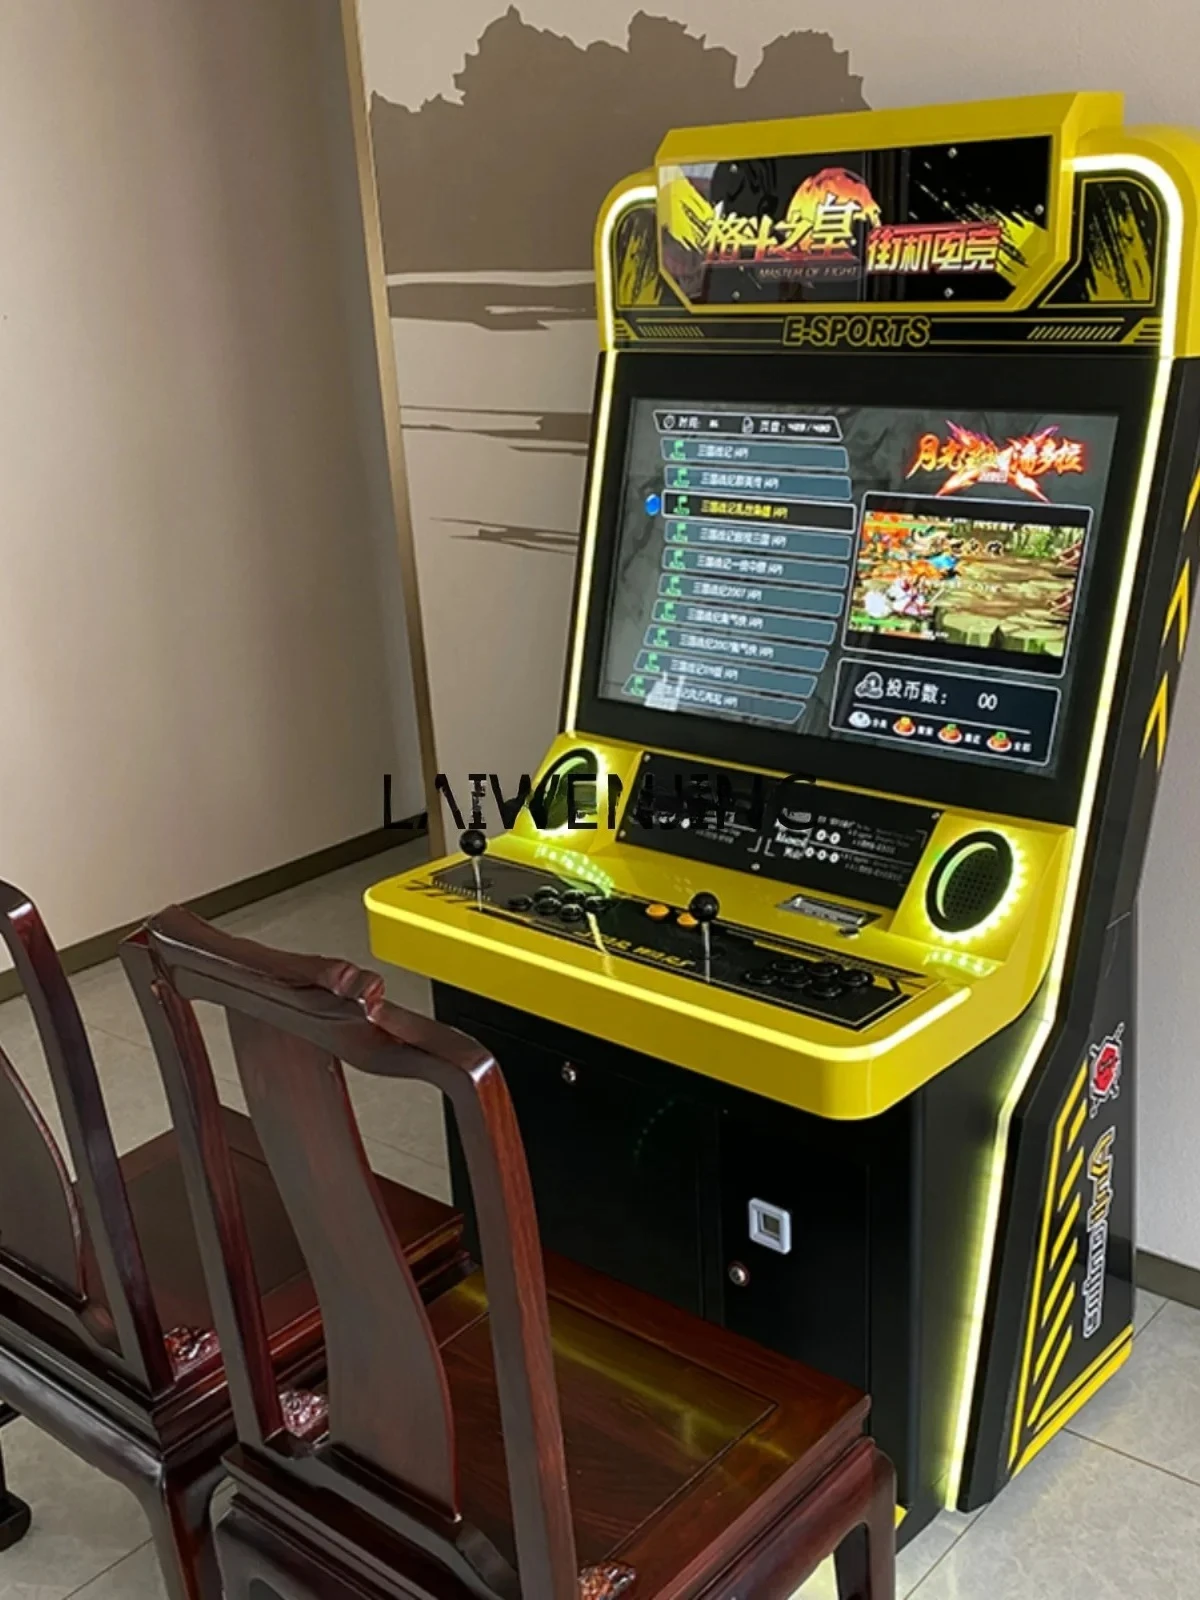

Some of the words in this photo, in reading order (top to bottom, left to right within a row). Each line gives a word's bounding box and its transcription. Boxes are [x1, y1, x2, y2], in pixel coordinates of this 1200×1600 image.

[866, 224, 1000, 273] 街机电竞
[783, 315, 931, 347] E-SPORTS
